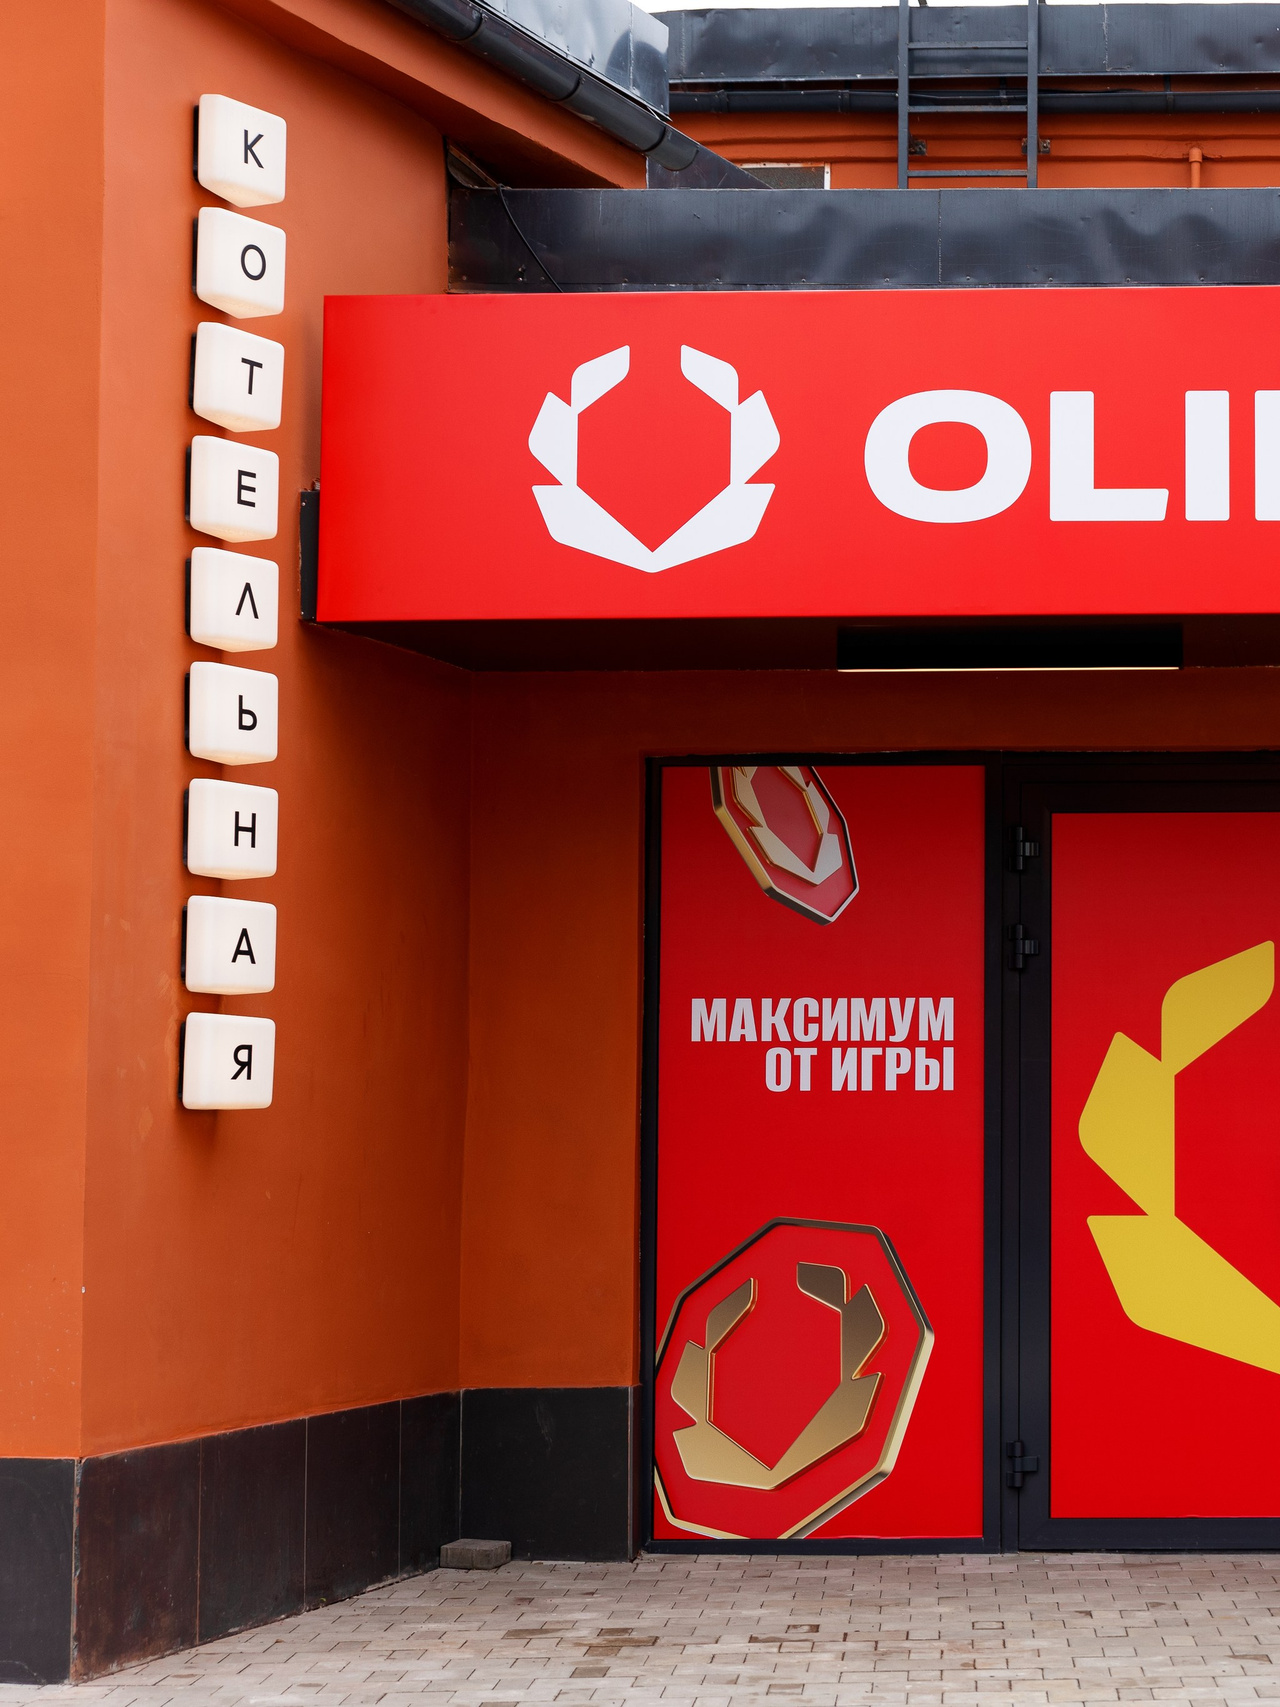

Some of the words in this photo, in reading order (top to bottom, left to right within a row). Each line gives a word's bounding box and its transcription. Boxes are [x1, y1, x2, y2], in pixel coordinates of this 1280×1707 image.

[230, 129, 267, 1081] КОТЕЛЬНАЯ
[691, 997, 954, 1043] МАКСИМУМ
[765, 1046, 818, 1093] ОТ
[831, 1046, 955, 1091] ИГРЫ
